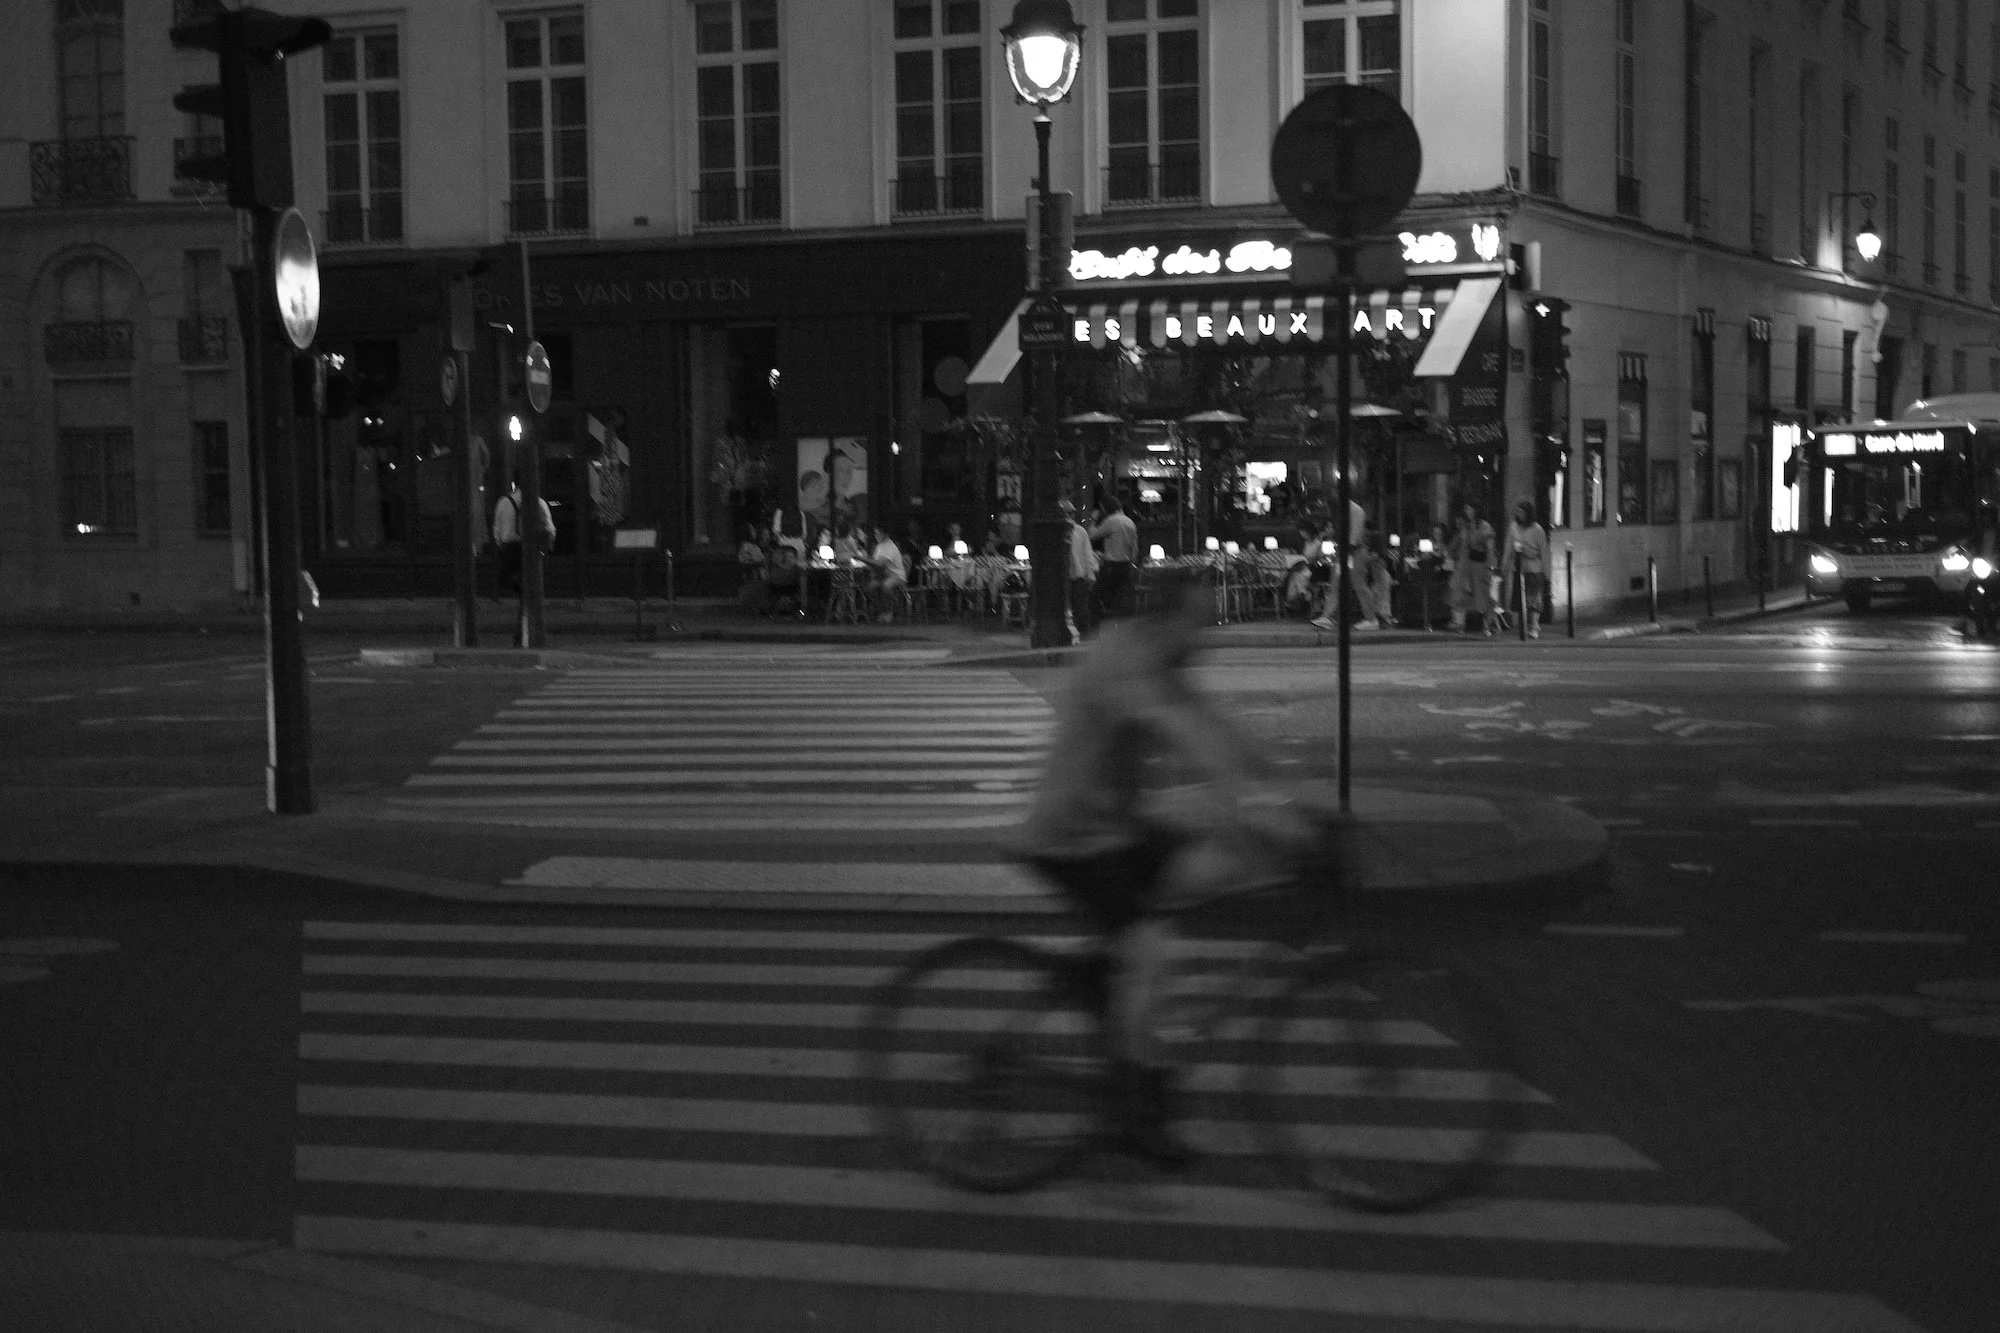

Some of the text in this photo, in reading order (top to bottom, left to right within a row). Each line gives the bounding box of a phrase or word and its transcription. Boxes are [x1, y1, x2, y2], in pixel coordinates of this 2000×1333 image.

[574, 281, 633, 306] VAN
[644, 277, 751, 303] NOTEN
[1074, 307, 1436, 342] ES BEAUX ART
